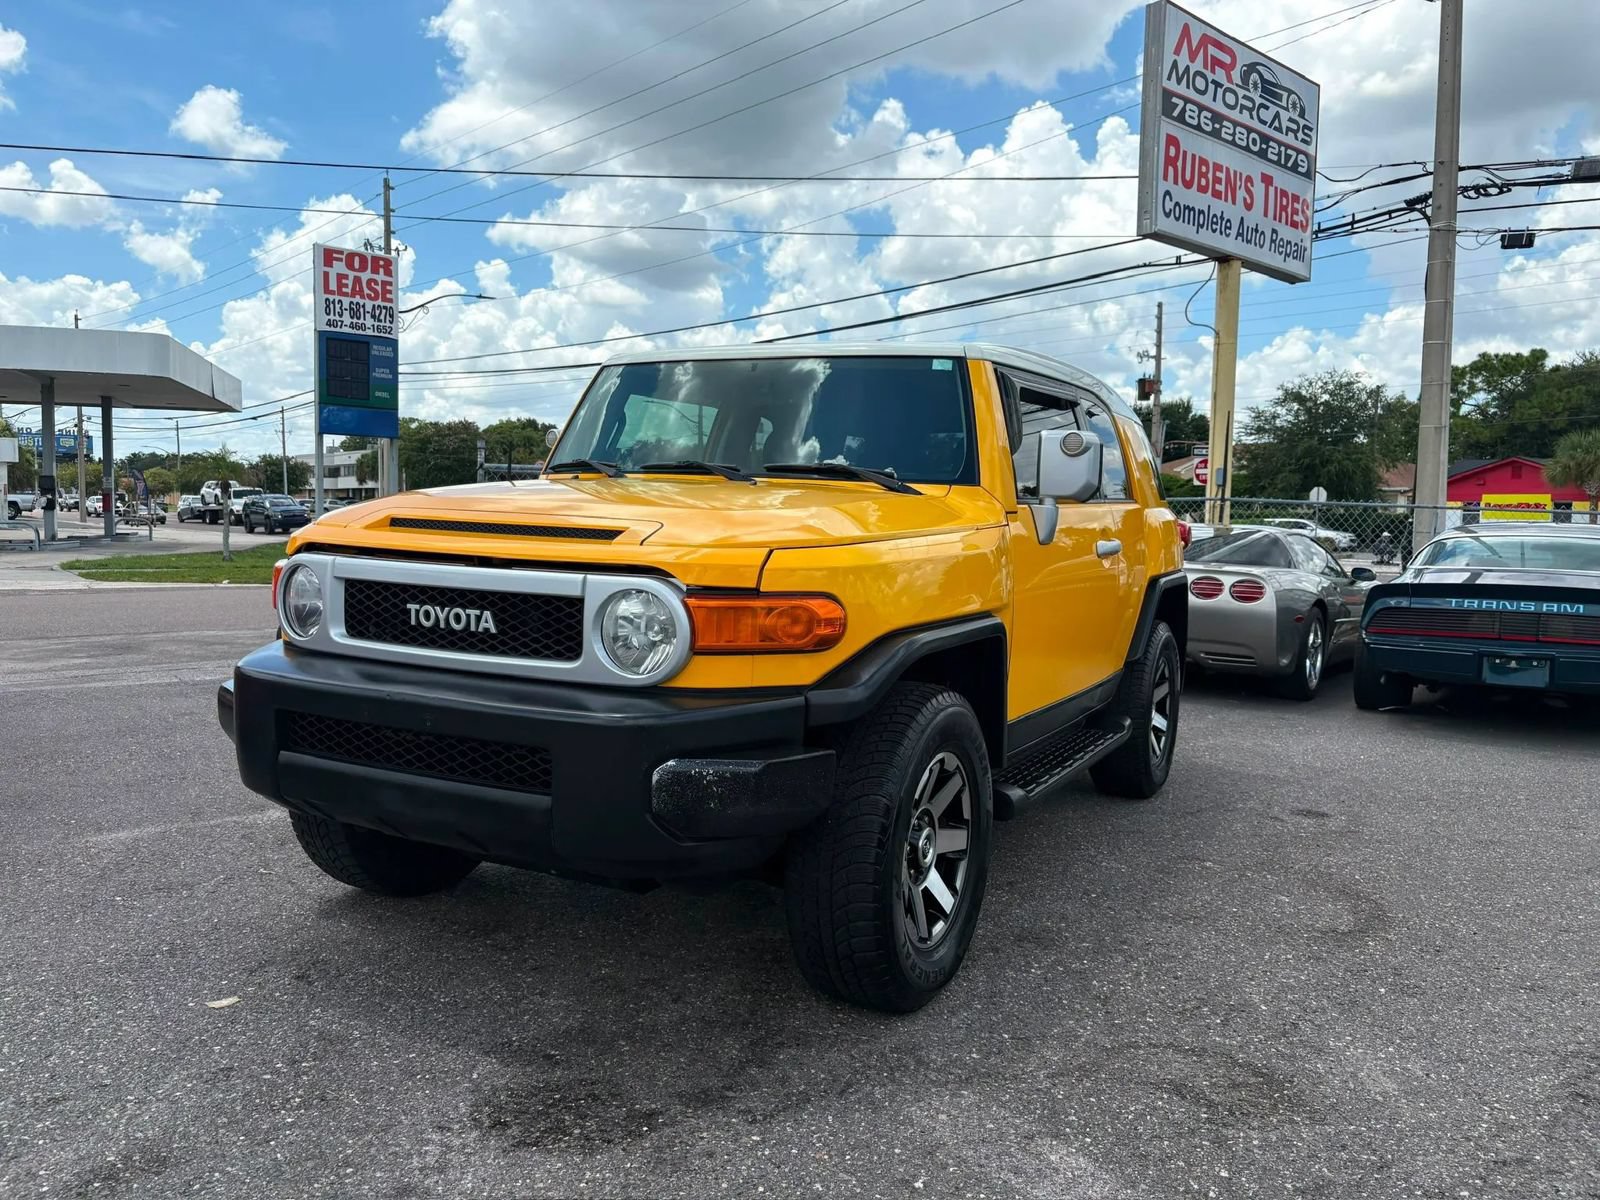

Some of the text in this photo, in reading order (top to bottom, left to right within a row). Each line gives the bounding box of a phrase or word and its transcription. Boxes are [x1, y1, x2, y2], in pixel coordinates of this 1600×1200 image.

[1173, 22, 1238, 85] MR
[1166, 59, 1314, 147] MOTORCARS
[1170, 97, 1309, 174] 786-280-2179
[1163, 133, 1310, 234] RUBEN'S TIRES
[1162, 190, 1307, 263] Complete Auto Repair
[323, 247, 393, 278] FOR
[323, 271, 393, 303] LEASE
[324, 298, 394, 325] 813-681-4279
[325, 318, 393, 336] 407-460-1652
[406, 603, 497, 633] TOYOTA
[1446, 599, 1584, 613] TRANS AM
